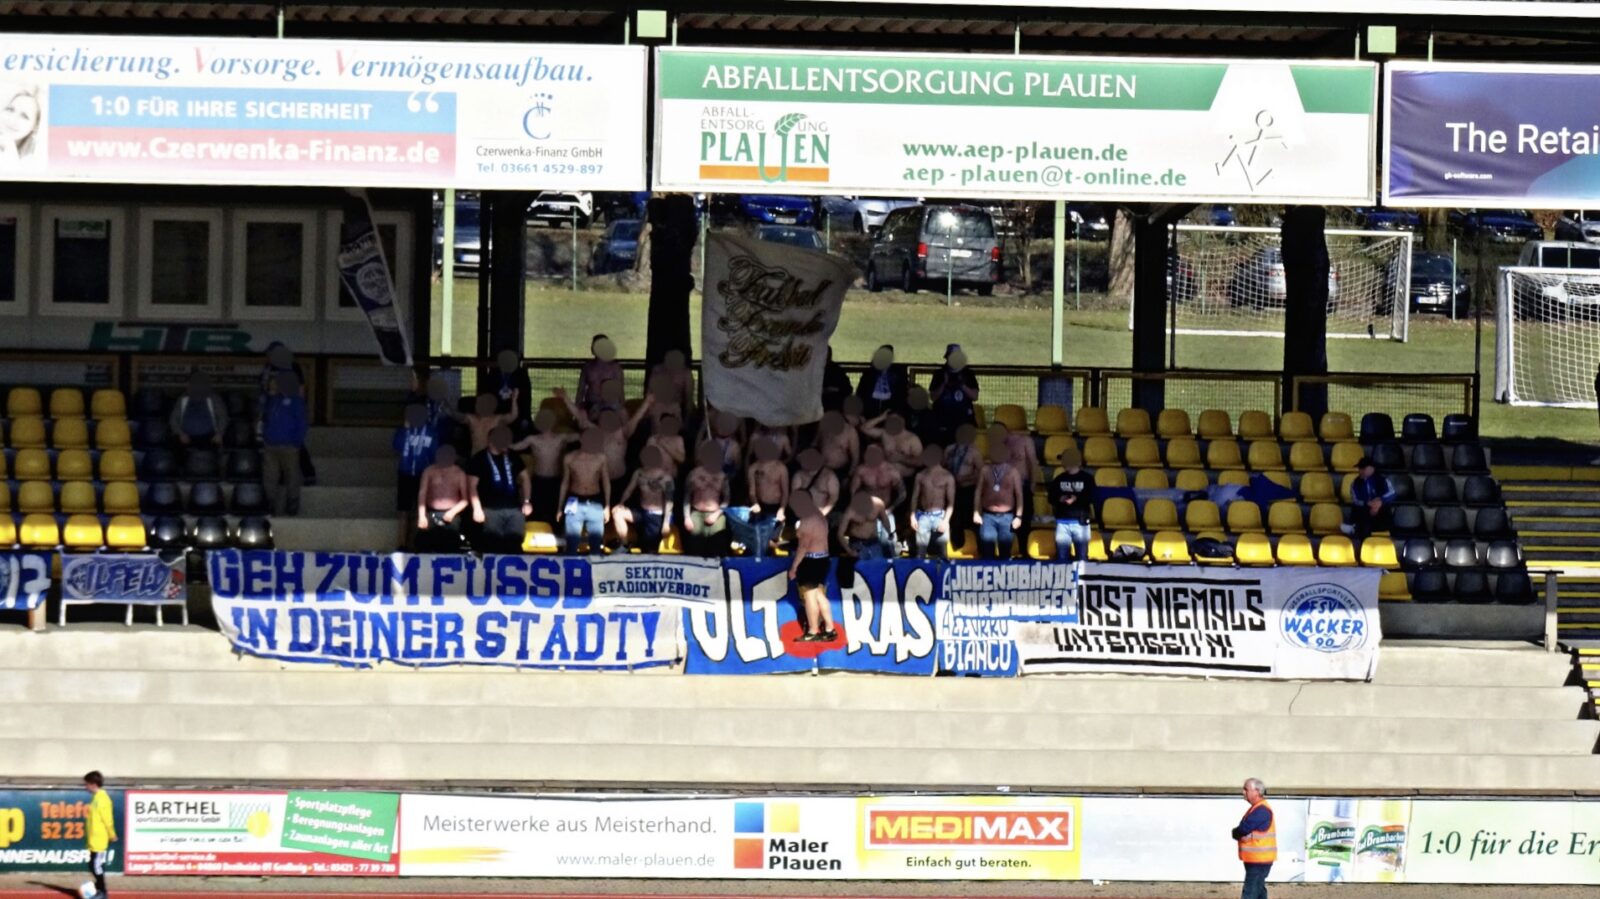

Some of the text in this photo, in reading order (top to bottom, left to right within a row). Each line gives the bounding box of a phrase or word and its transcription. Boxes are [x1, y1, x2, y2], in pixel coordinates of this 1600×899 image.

[194, 47, 321, 81] Vorsorge.
[335, 49, 593, 86] Vermögensaufbau.
[702, 64, 1136, 99] ABFALLENTSORGUNG PLAUEN
[91, 96, 373, 121] 1:0 FÜR IHRE SICHERHEIT
[701, 106, 755, 117] ABFALL-
[1446, 122, 1598, 155] The Retai
[67, 136, 440, 164] www.Czerwenka-Finanz.de
[475, 145, 603, 158] Czerwenka-Finanz GmbH
[701, 131, 830, 183] PLAUEN
[903, 142, 1128, 163] www.aep-plauen.de
[501, 163, 538, 173] 03661
[543, 164, 604, 174] 4529-897
[209, 549, 594, 609] GEH ZUM FUSSB
[625, 566, 684, 580] SEKTION
[599, 581, 710, 598] STADIONVERBOT
[952, 589, 1077, 617] NORDHAUSEN
[1146, 586, 1266, 631] NIEMALS
[1310, 599, 1338, 614] FSV
[231, 607, 661, 662] IN DEINER STADT!
[1285, 617, 1364, 636] WACKER
[1315, 637, 1335, 647] 90
[943, 640, 1012, 671] BIANCO
[135, 801, 221, 815] BARTHEL
[41, 821, 85, 840] 52 23
[423, 814, 716, 834] Meisterwerke aus Meisterhand.
[875, 816, 1065, 840] MEDIMAX
[373, 843, 389, 854] Art
[769, 839, 829, 853] Maler
[1420, 829, 1600, 863] 1:0 für die Er
[556, 853, 716, 870] www.maler-plauen.de
[769, 856, 842, 871] Plauen
[906, 856, 1031, 870] Einfach gut beraten.
